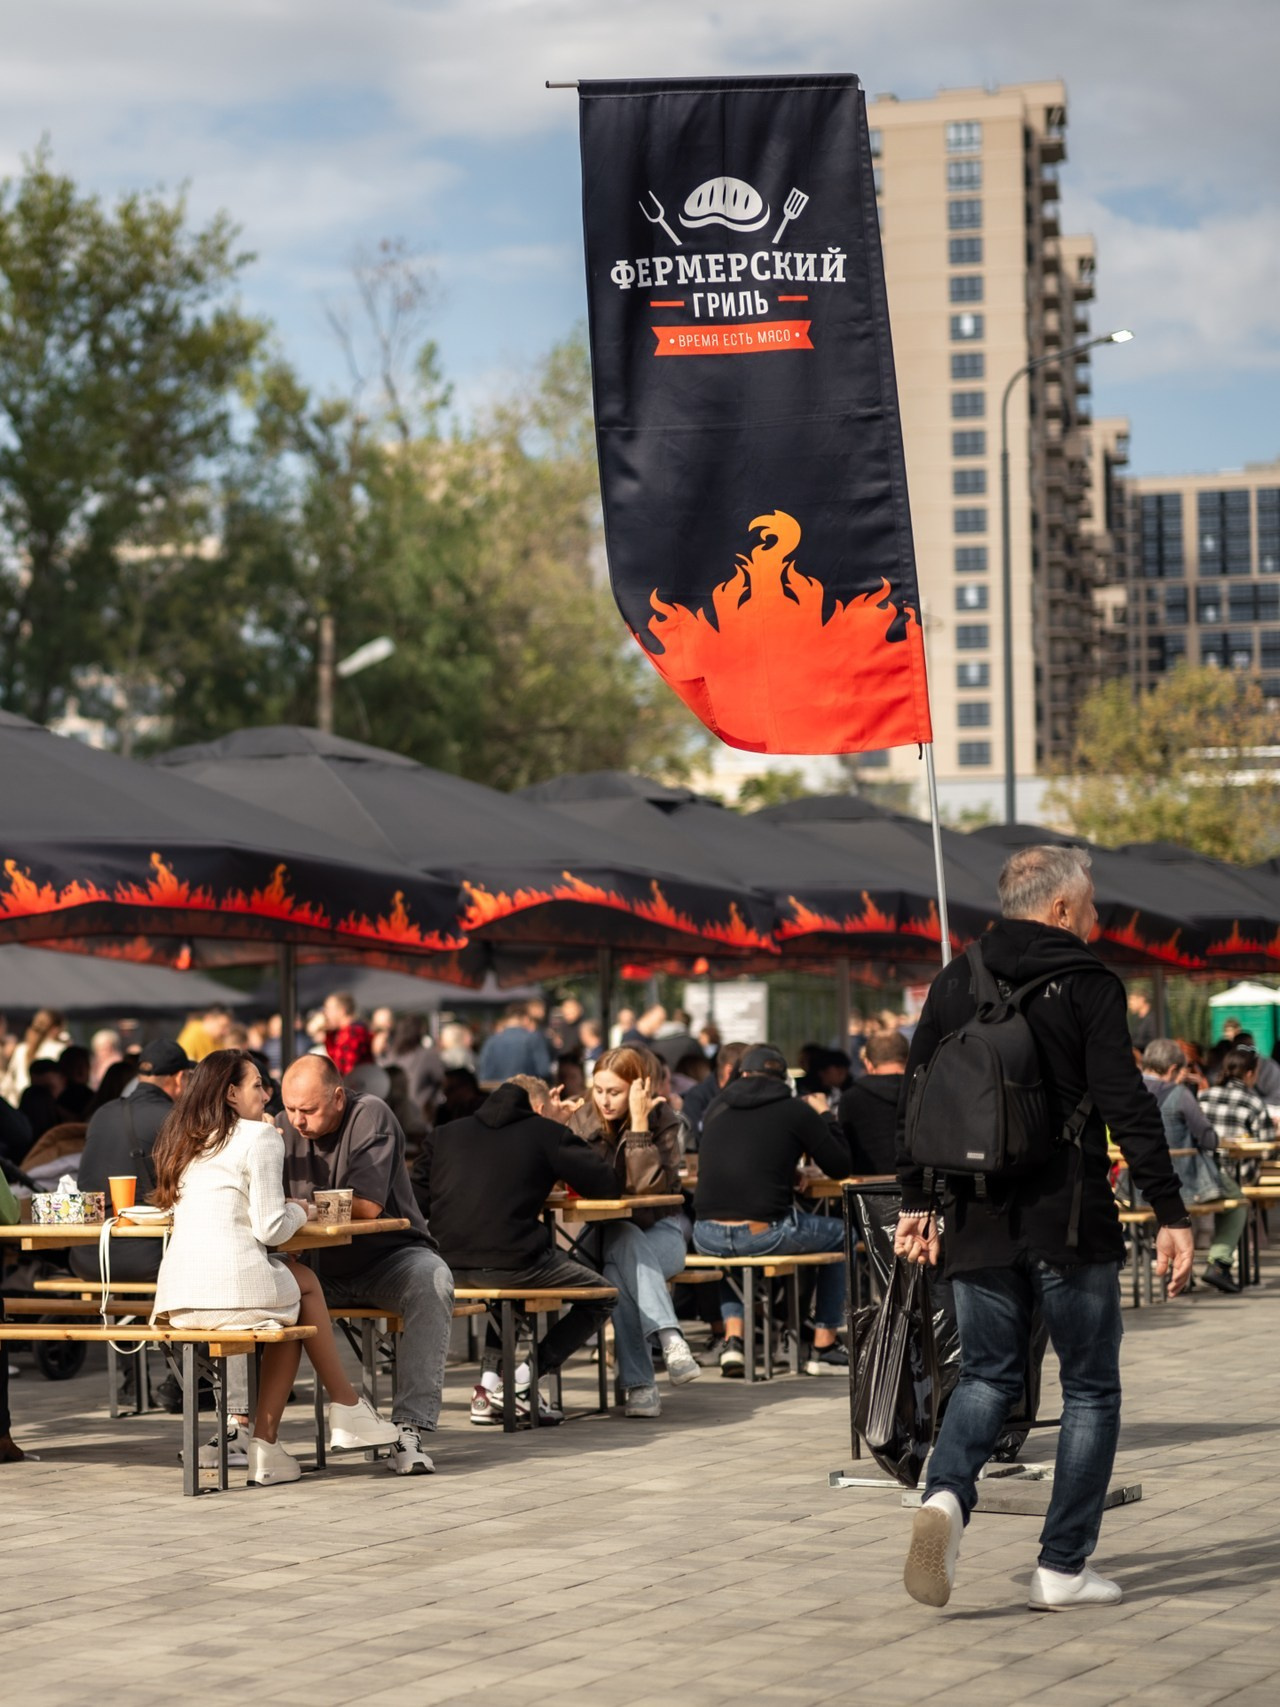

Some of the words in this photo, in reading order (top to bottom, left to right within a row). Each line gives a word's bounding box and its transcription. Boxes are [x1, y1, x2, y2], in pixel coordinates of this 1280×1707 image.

[610, 247, 847, 290] ФЕРМЕРСКИЙ
[693, 290, 769, 318] ГРИЛЬ
[678, 334, 719, 347] ВРЕМЯ
[723, 332, 753, 346] ЕСТЬ
[757, 328, 791, 344] МЯСО
